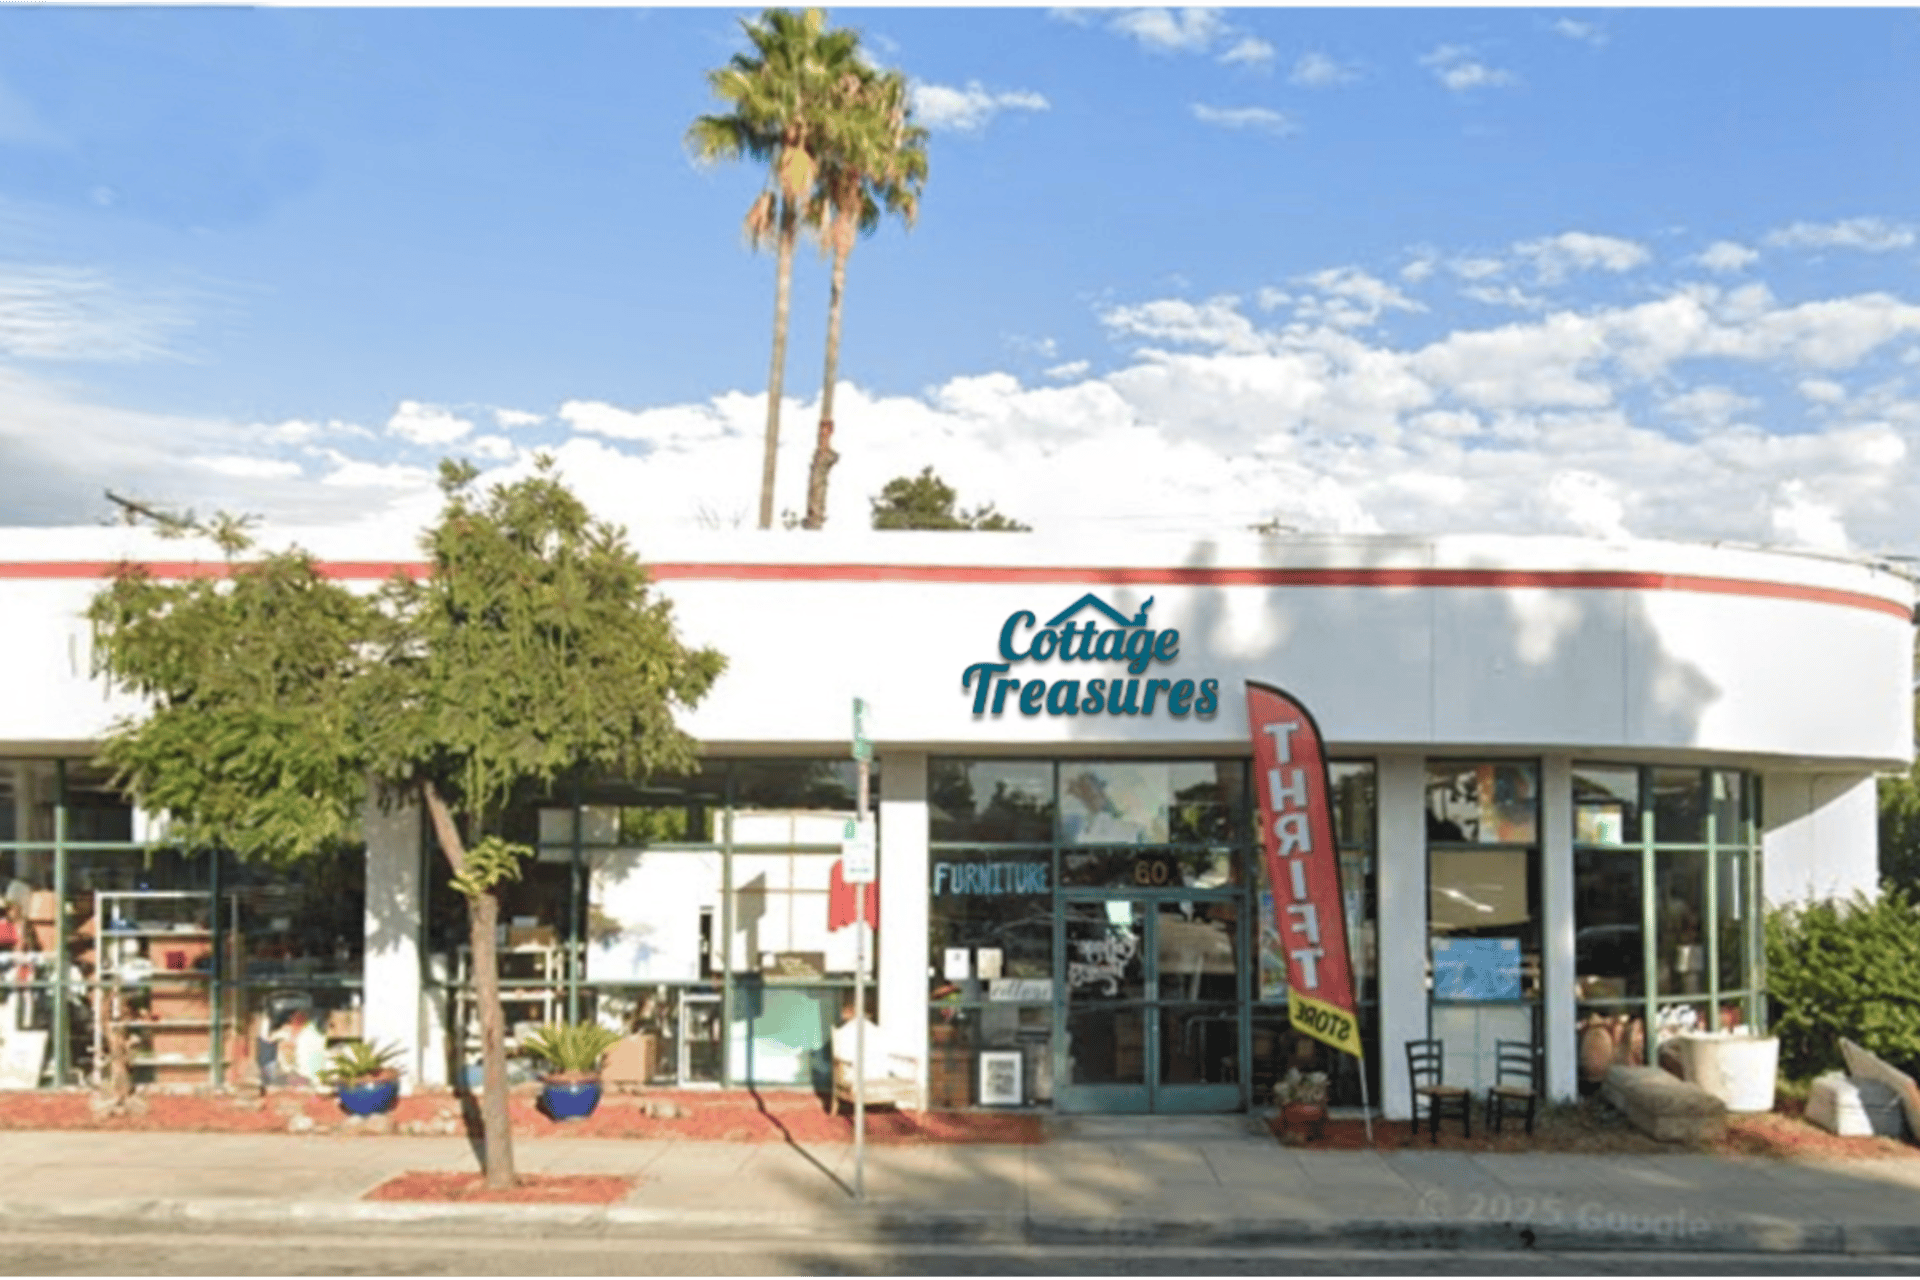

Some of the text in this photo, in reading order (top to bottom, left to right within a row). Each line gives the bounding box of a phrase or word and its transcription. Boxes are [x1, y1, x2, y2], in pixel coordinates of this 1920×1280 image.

[999, 609, 1180, 674] Cottage
[962, 662, 1218, 716] Treasures
[933, 861, 1050, 896] FURNITURE
